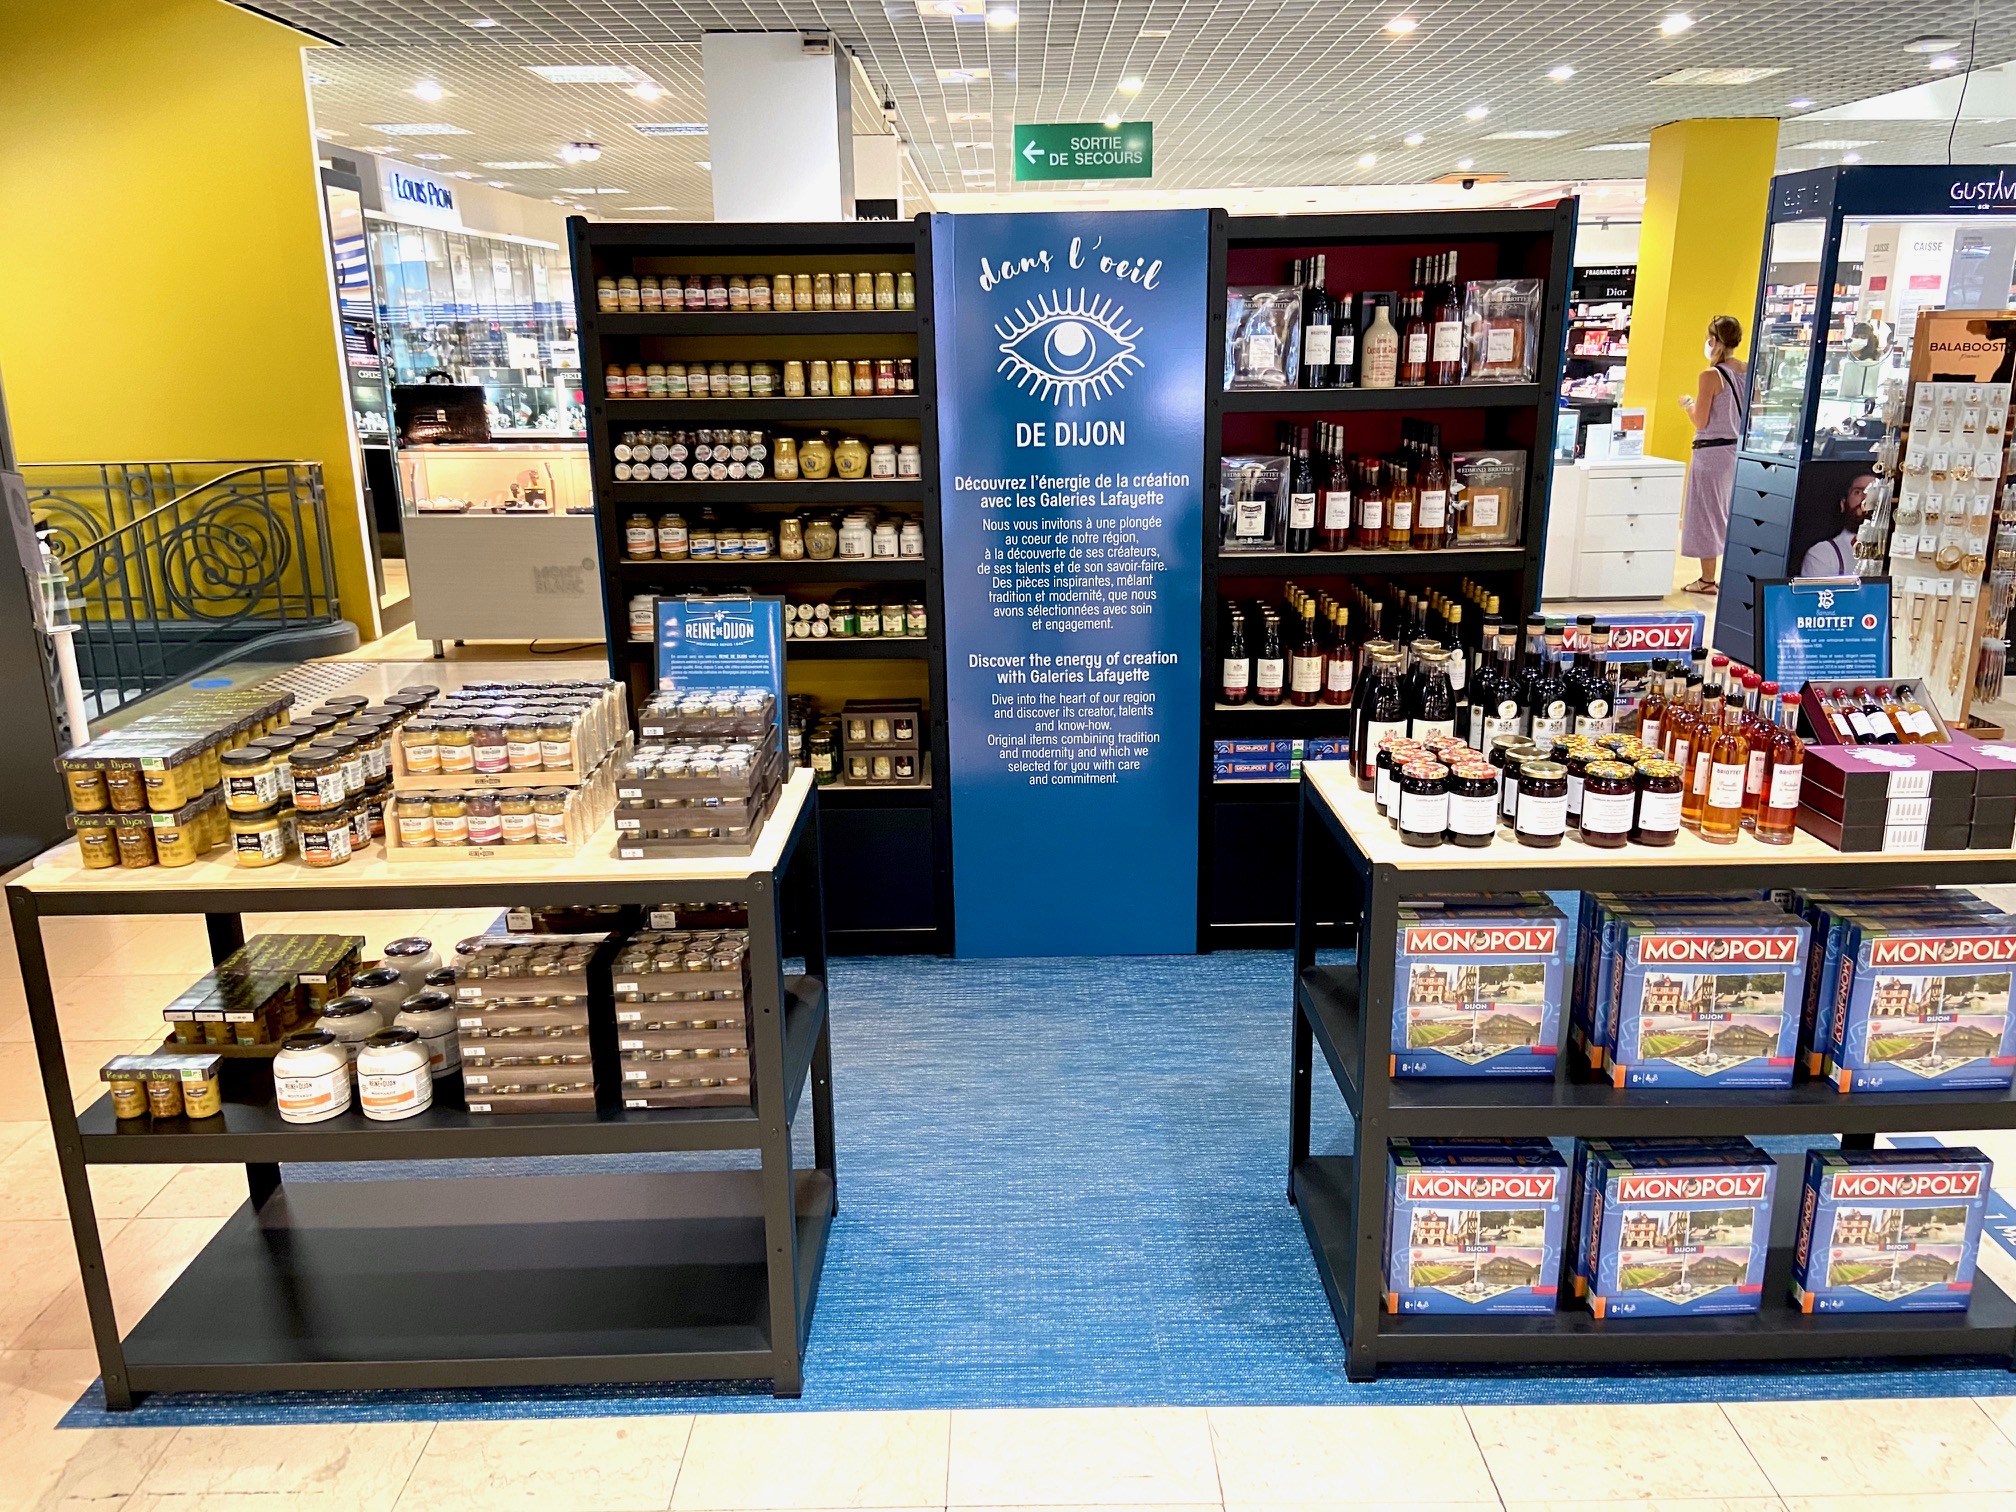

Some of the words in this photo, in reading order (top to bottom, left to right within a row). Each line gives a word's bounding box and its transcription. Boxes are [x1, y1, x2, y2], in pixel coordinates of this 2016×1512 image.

[1070, 136, 1122, 150] SORTIE
[1049, 152, 1069, 166] DE
[1074, 151, 1143, 165] SECOURS
[394, 172, 426, 204] LOUIS
[428, 181, 454, 210] PION
[1950, 169, 2016, 200] GUSTAV
[1913, 242, 1943, 252] CAISSE
[979, 250, 1054, 291] dans
[1583, 268, 1621, 278] FRAGRANCES
[1606, 288, 1627, 296] Dior
[1016, 422, 1046, 448] DE
[1055, 421, 1125, 447] DIJON
[955, 476, 1026, 490] Découvrez
[1031, 474, 1090, 492] l'énergie
[1095, 474, 1111, 488] de
[1117, 473, 1128, 487] la
[1133, 473, 1189, 487] création
[980, 496, 1011, 508] avec
[1017, 493, 1035, 507] les
[1041, 492, 1095, 506] Galeries
[1101, 491, 1164, 508] Lafayette
[983, 519, 1009, 530] Nous
[1013, 521, 1038, 530] vous
[1041, 518, 1082, 530] invitons
[1086, 518, 1092, 529] à
[1096, 519, 1115, 529] une
[1119, 517, 1161, 530] plongée
[1005, 535, 1018, 545] au
[1022, 535, 1051, 545] coeur
[1055, 533, 1068, 544] de
[1072, 533, 1098, 544] notre
[1103, 532, 1138, 545] région,
[985, 548, 990, 560] à
[995, 548, 1003, 559] la
[1007, 547, 1065, 559] découverte
[1069, 546, 1082, 558] de
[1086, 548, 1103, 557] ses
[1107, 546, 1160, 558] créateurs,
[977, 563, 990, 574] de
[994, 564, 1011, 574] ses
[1015, 562, 1050, 573] talents
[1054, 562, 1064, 572] et
[1068, 562, 1080, 572] de
[1084, 563, 1103, 572] son
[1107, 560, 1167, 571] savoir-faire.
[993, 577, 1012, 588] Des
[1016, 577, 1049, 590] pièces
[1053, 576, 1113, 589] inspirantes,
[1117, 575, 1153, 586] mêlant
[989, 591, 1031, 602] tradition
[1035, 591, 1045, 601] et
[1049, 590, 1104, 602] modernité,
[1108, 591, 1127, 602] que
[1132, 589, 1156, 599] nous
[994, 606, 1023, 617] avons
[1027, 604, 1099, 616] sélectionnées
[1103, 604, 1127, 614] avec
[1130, 603, 1152, 614] soin
[1032, 619, 1042, 630] et
[1046, 619, 1113, 632] engagement.
[1797, 616, 1855, 629] BRIOTTET
[685, 622, 716, 640] REINE
[716, 626, 723, 636] DE
[723, 622, 754, 640] DIJON
[969, 654, 1025, 668] Discover
[1030, 653, 1051, 666] the
[1056, 654, 1101, 668] energy
[1106, 652, 1119, 665] of
[1124, 651, 1178, 665] creation
[997, 670, 1025, 683] with
[1031, 670, 1083, 683] Galeries
[1089, 668, 1149, 684] Lafayette
[992, 694, 1013, 705] Dive
[1017, 693, 1035, 704] into
[1040, 693, 1055, 704] the
[1060, 693, 1086, 703] heart
[1090, 692, 1100, 703] of
[1103, 693, 1119, 703] our
[1124, 692, 1155, 704] region
[994, 707, 1013, 718] and
[1017, 707, 1059, 718] discover
[1063, 706, 1074, 717] its
[1078, 706, 1115, 718] creator,
[1119, 706, 1153, 716] talents
[1035, 720, 1053, 731] and
[1058, 720, 1111, 730] know-how.
[988, 735, 1026, 747] Original
[1030, 734, 1057, 745] items
[1061, 733, 1114, 746] combining
[1118, 732, 1159, 743] tradition
[1000, 748, 1018, 758] and
[1022, 748, 1074, 760] modernity
[1078, 747, 1096, 757] and
[1100, 746, 1130, 757] which
[1134, 747, 1148, 756] we
[62, 759, 89, 769] Reine
[94, 760, 106, 769] de
[111, 759, 136, 771] Dijon
[1008, 761, 1050, 771] selected
[1054, 760, 1067, 770] for
[1071, 761, 1089, 772] you
[1093, 759, 1114, 770] with
[1118, 760, 1140, 769] care
[1029, 774, 1048, 784] and
[1052, 773, 1118, 784] commitment.
[73, 816, 99, 826] Reine
[105, 817, 116, 826] de
[121, 816, 146, 827] Dijon
[1409, 930, 1552, 951] MONOPOLY
[1643, 938, 1793, 960] MONOPOLY
[1875, 937, 2016, 963] MONOPOLY
[1834, 959, 1853, 1042] MONOPOLY
[1402, 1063, 1411, 1071] 8+
[105, 1070, 130, 1079] Reine
[136, 1071, 147, 1079] de
[152, 1070, 175, 1081] Dijon
[1632, 1074, 1641, 1082] 8+
[1857, 1077, 1867, 1086] 8+
[1411, 1177, 1552, 1197] MONOPOLY
[1622, 1176, 1761, 1199] MONOPOLY
[1837, 1174, 1977, 1195] MONOPOLY
[1797, 1189, 1816, 1266] MONOPOLY
[1404, 1301, 1413, 1309] 8+
